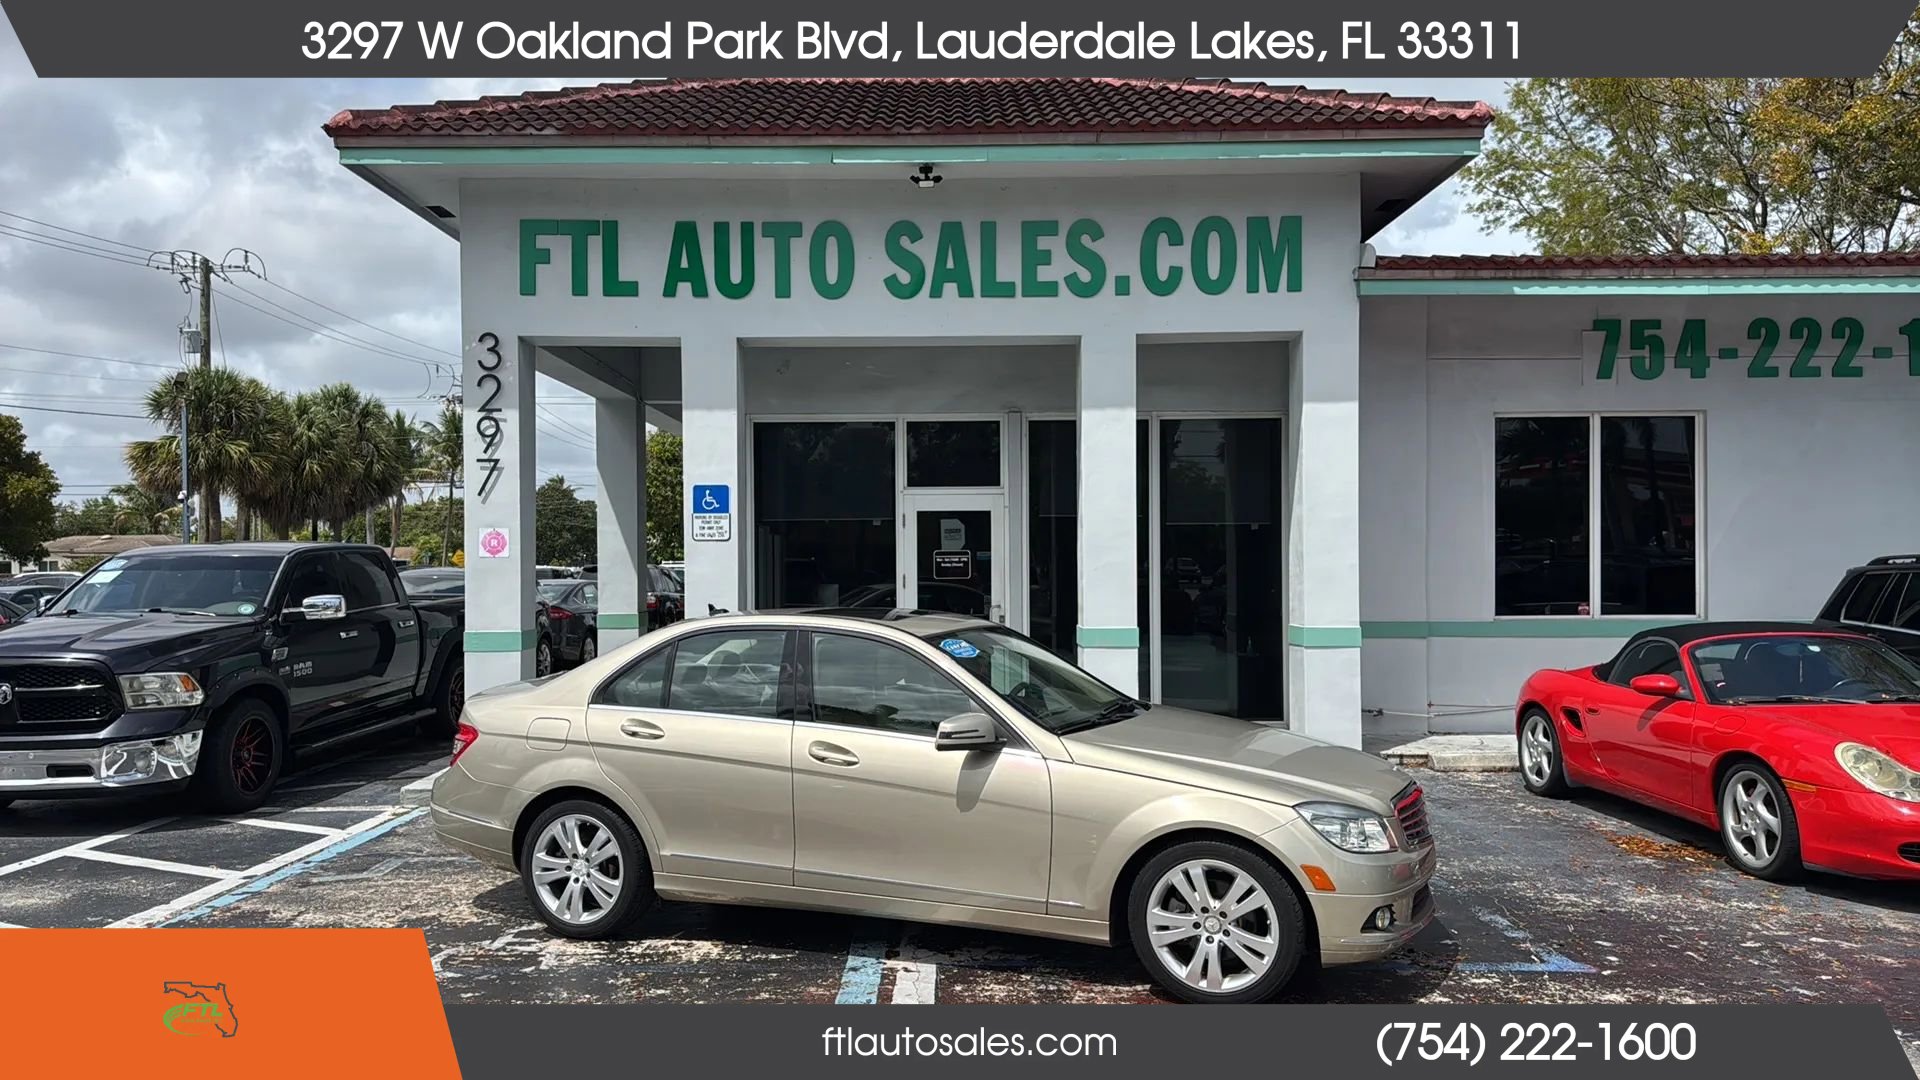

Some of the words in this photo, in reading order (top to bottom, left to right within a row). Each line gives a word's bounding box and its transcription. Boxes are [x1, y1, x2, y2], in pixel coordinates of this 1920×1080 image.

[519, 219, 639, 297] FTL
[662, 219, 855, 300] AUTO
[883, 215, 1303, 300] SALES.COM
[476, 331, 503, 497] 3297
[293, 668, 312, 677] 1500
